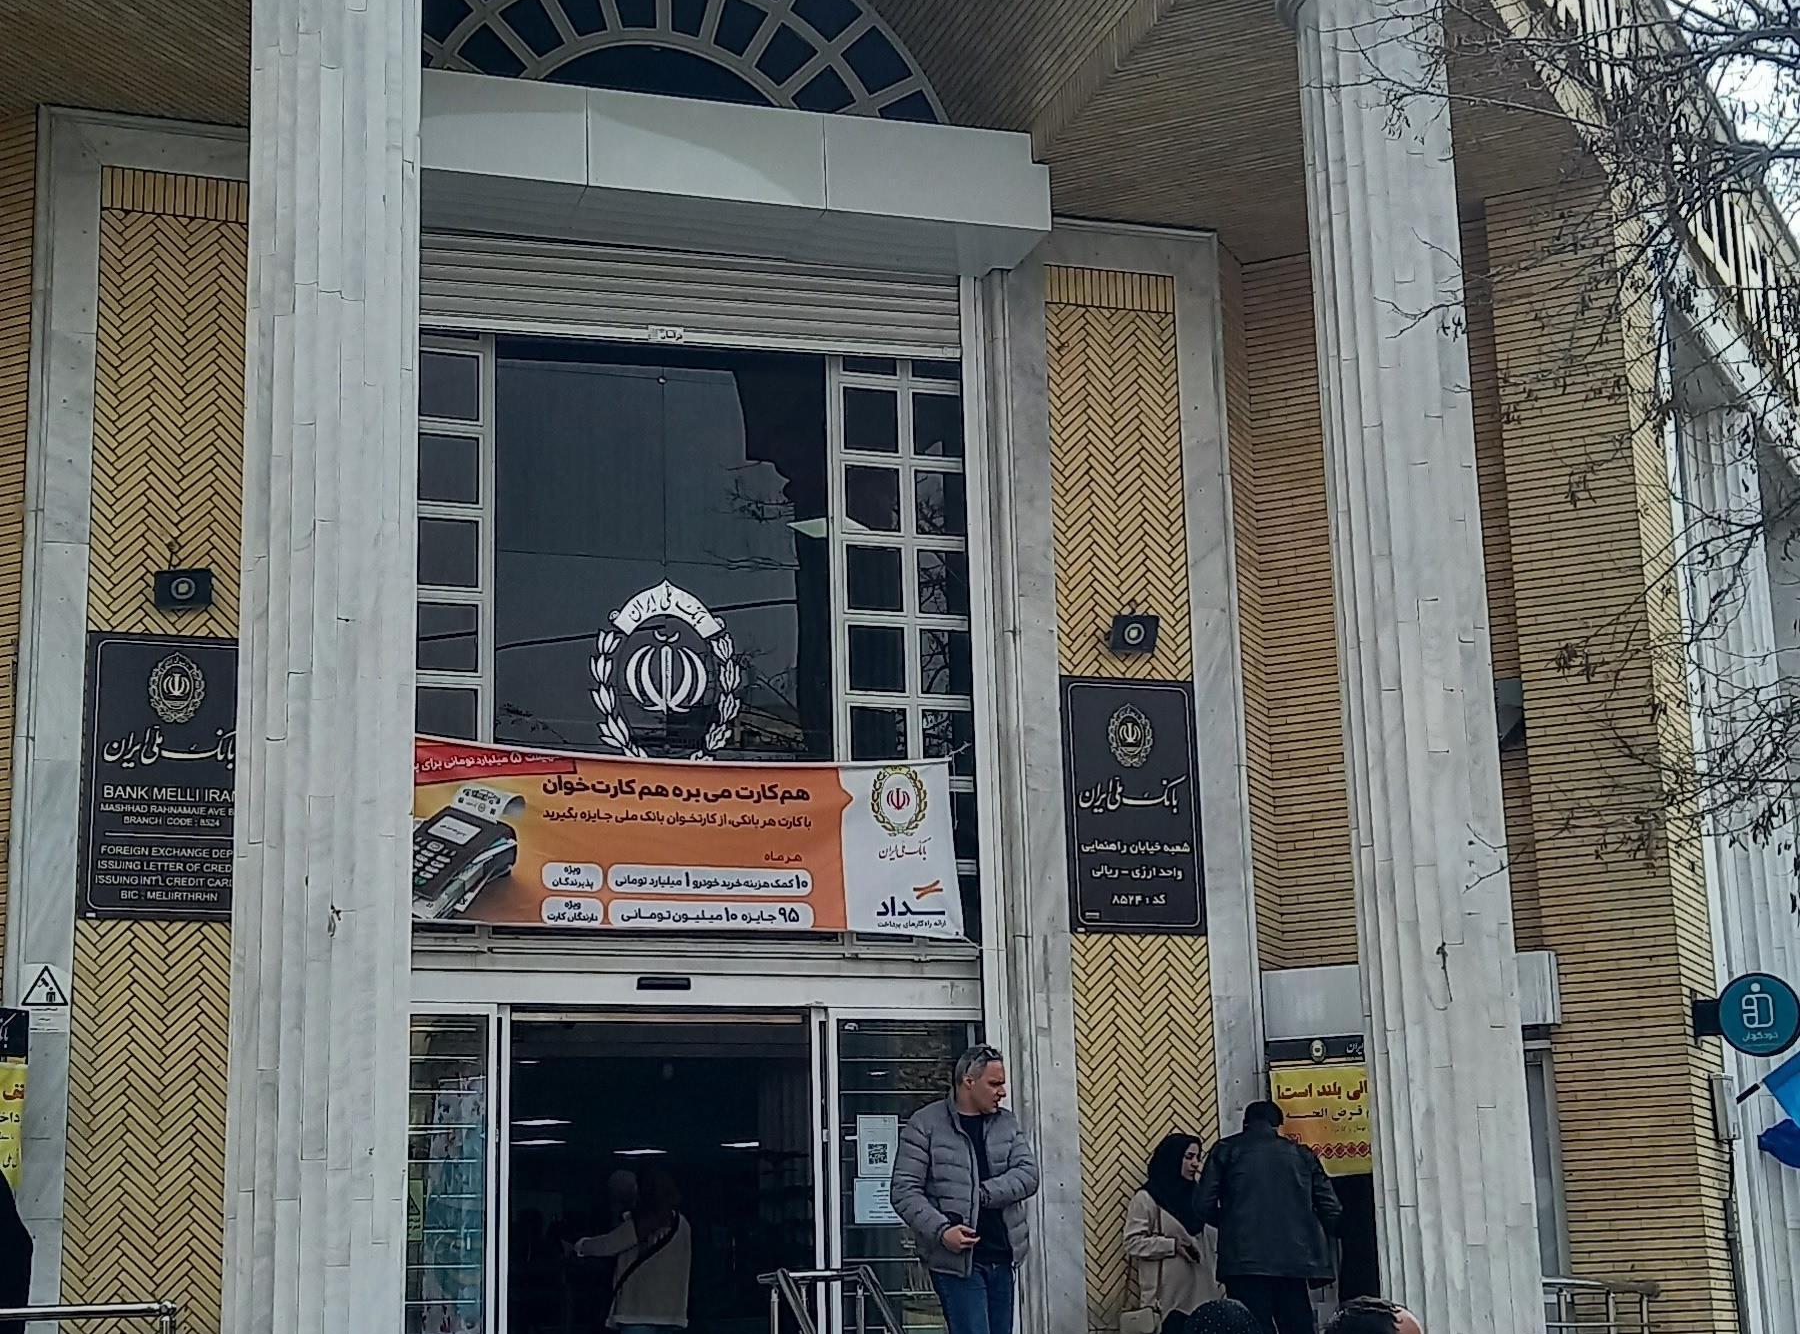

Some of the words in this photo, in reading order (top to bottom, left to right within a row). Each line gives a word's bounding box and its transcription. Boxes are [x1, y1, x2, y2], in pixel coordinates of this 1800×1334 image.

[103, 727, 151, 768] ایران
[443, 756, 475, 770] تومانی
[476, 755, 509, 767] میلیارد
[103, 784, 149, 800] BANK
[152, 786, 200, 802] MELLI
[638, 783, 670, 801] هم
[671, 785, 702, 803] بره
[703, 787, 733, 803] می
[735, 783, 779, 804] کارت
[779, 786, 810, 805] هم
[1078, 778, 1113, 814] ایران
[1121, 774, 1187, 814] بانک
[100, 802, 148, 814] MASHHAD
[150, 804, 206, 816] RAHNAMAIE
[207, 806, 226, 817] AVE
[542, 806, 578, 822] بگیرید
[580, 808, 613, 823] جایزه
[614, 808, 638, 824] ملی
[123, 815, 162, 826] BRANCH
[166, 817, 193, 827] CODE
[639, 809, 665, 825] بانک
[718, 812, 727, 827] از
[760, 816, 777, 829] هر
[777, 815, 803, 830] کارت
[803, 816, 812, 831] با
[100, 844, 149, 856] FOREIGN
[151, 847, 210, 858] EXCHANGE
[1081, 839, 1127, 854] راهنمایی
[1129, 840, 1161, 854] خیابان
[1162, 842, 1191, 855] شعبه
[763, 850, 785, 862] ماه
[784, 853, 802, 864] هر
[97, 859, 141, 871] ISSUING
[143, 861, 184, 872] LETTER
[185, 862, 201, 872] OF
[563, 864, 581, 876] ویژه
[1091, 864, 1119, 878] ریالی
[1131, 866, 1157, 879] ارزی
[1158, 866, 1183, 880] واحد
[95, 874, 139, 885] ISSUING
[165, 877, 206, 887] CREDIT
[614, 874, 648, 887] تومانی
[648, 875, 683, 888] میلیارد
[692, 877, 720, 890] خودرو
[720, 878, 743, 890] خرید
[744, 878, 770, 891] هزینه
[771, 878, 794, 889] کمک
[120, 890, 139, 900] BIC
[1152, 894, 1166, 905] کد
[563, 900, 582, 910] ویژه
[546, 911, 566, 923] کارت
[620, 907, 671, 923] تومانی
[671, 909, 723, 924] میلیون
[741, 910, 777, 925] جایزه
